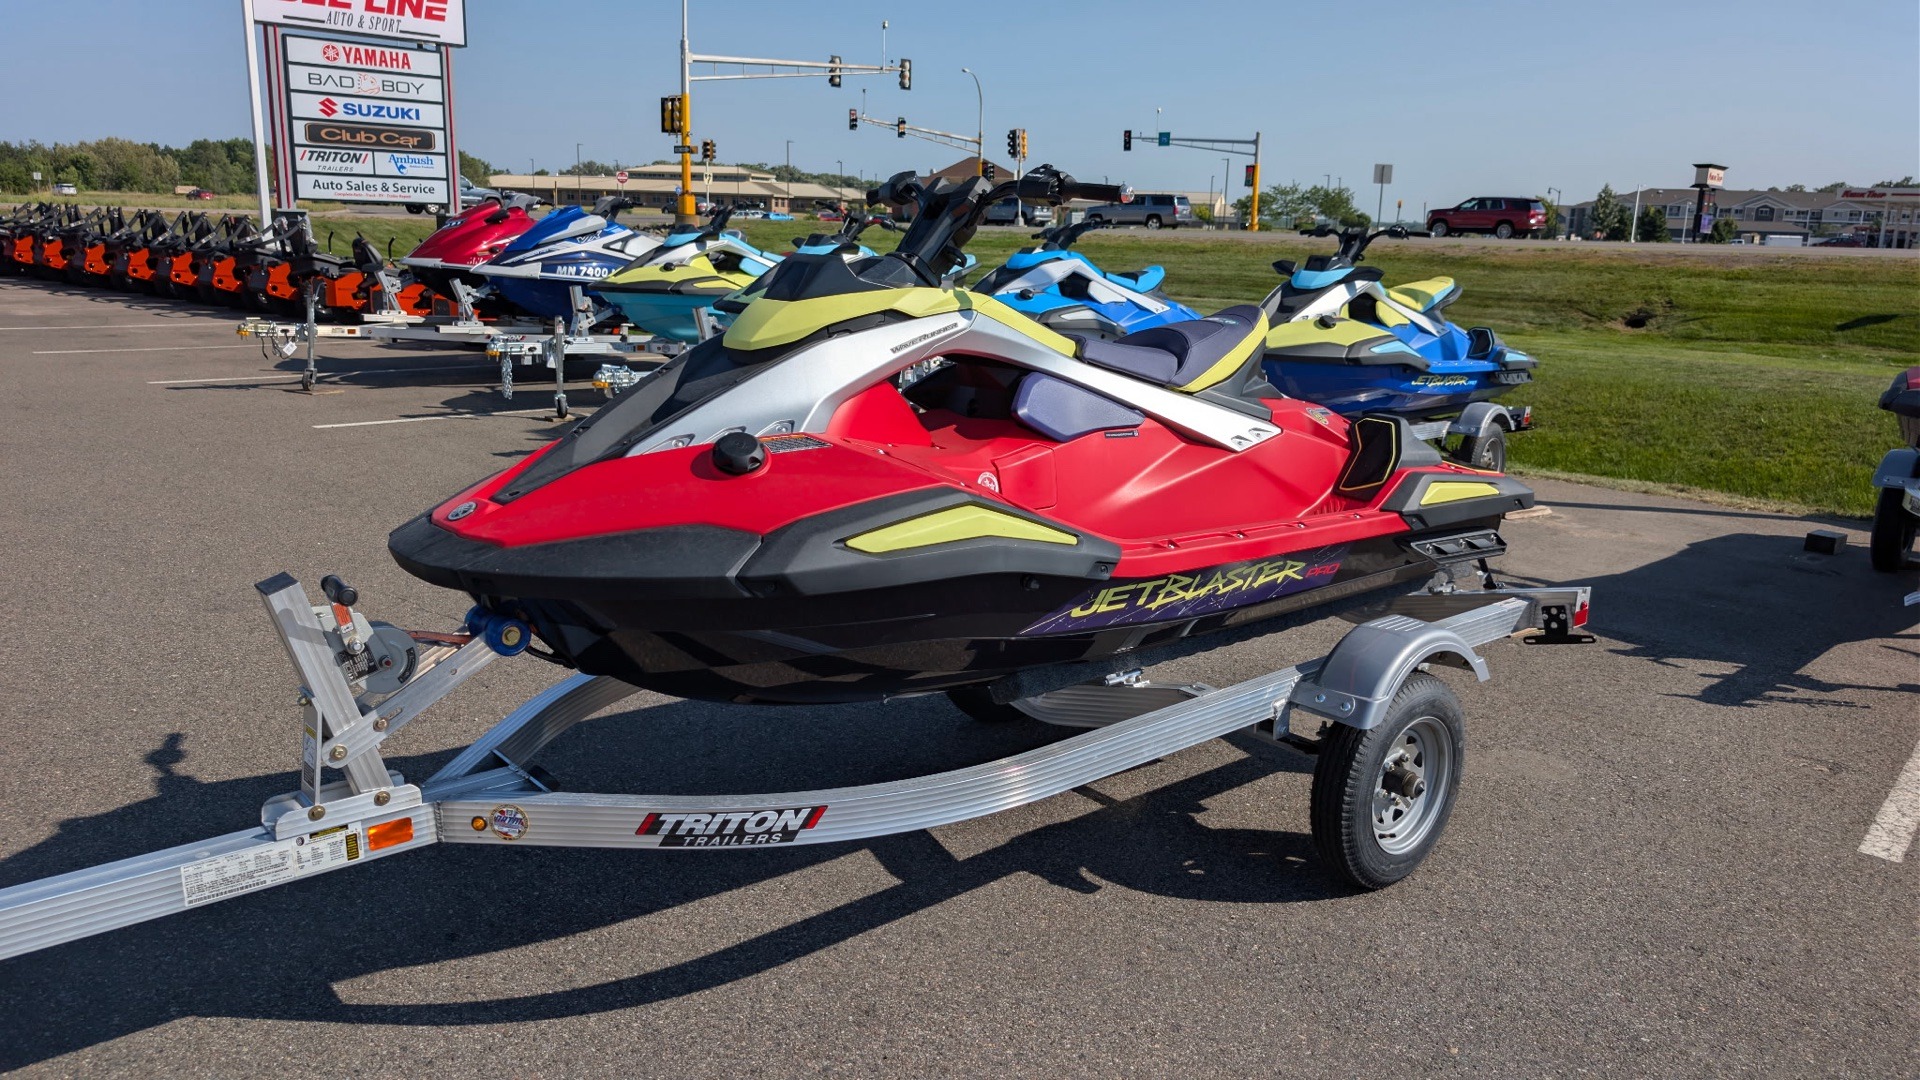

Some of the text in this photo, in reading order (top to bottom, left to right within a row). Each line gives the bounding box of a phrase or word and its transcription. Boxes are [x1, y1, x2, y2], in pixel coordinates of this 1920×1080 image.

[326, 11, 402, 33] AUTO & SPORT
[342, 46, 411, 70] YAMAHA
[308, 73, 424, 95] BAD BOY
[342, 102, 421, 120] SUZUKI
[320, 127, 421, 146] Club Car
[307, 150, 362, 164] TRITON
[388, 154, 434, 167] Ambush
[313, 179, 435, 194] Auto Sales & Service
[556, 265, 576, 276] MN
[579, 266, 609, 277] 7400
[1071, 560, 1341, 618] JETBLASTER PRO
[657, 807, 812, 835] TRITON
[682, 833, 783, 848] TRAILERS
